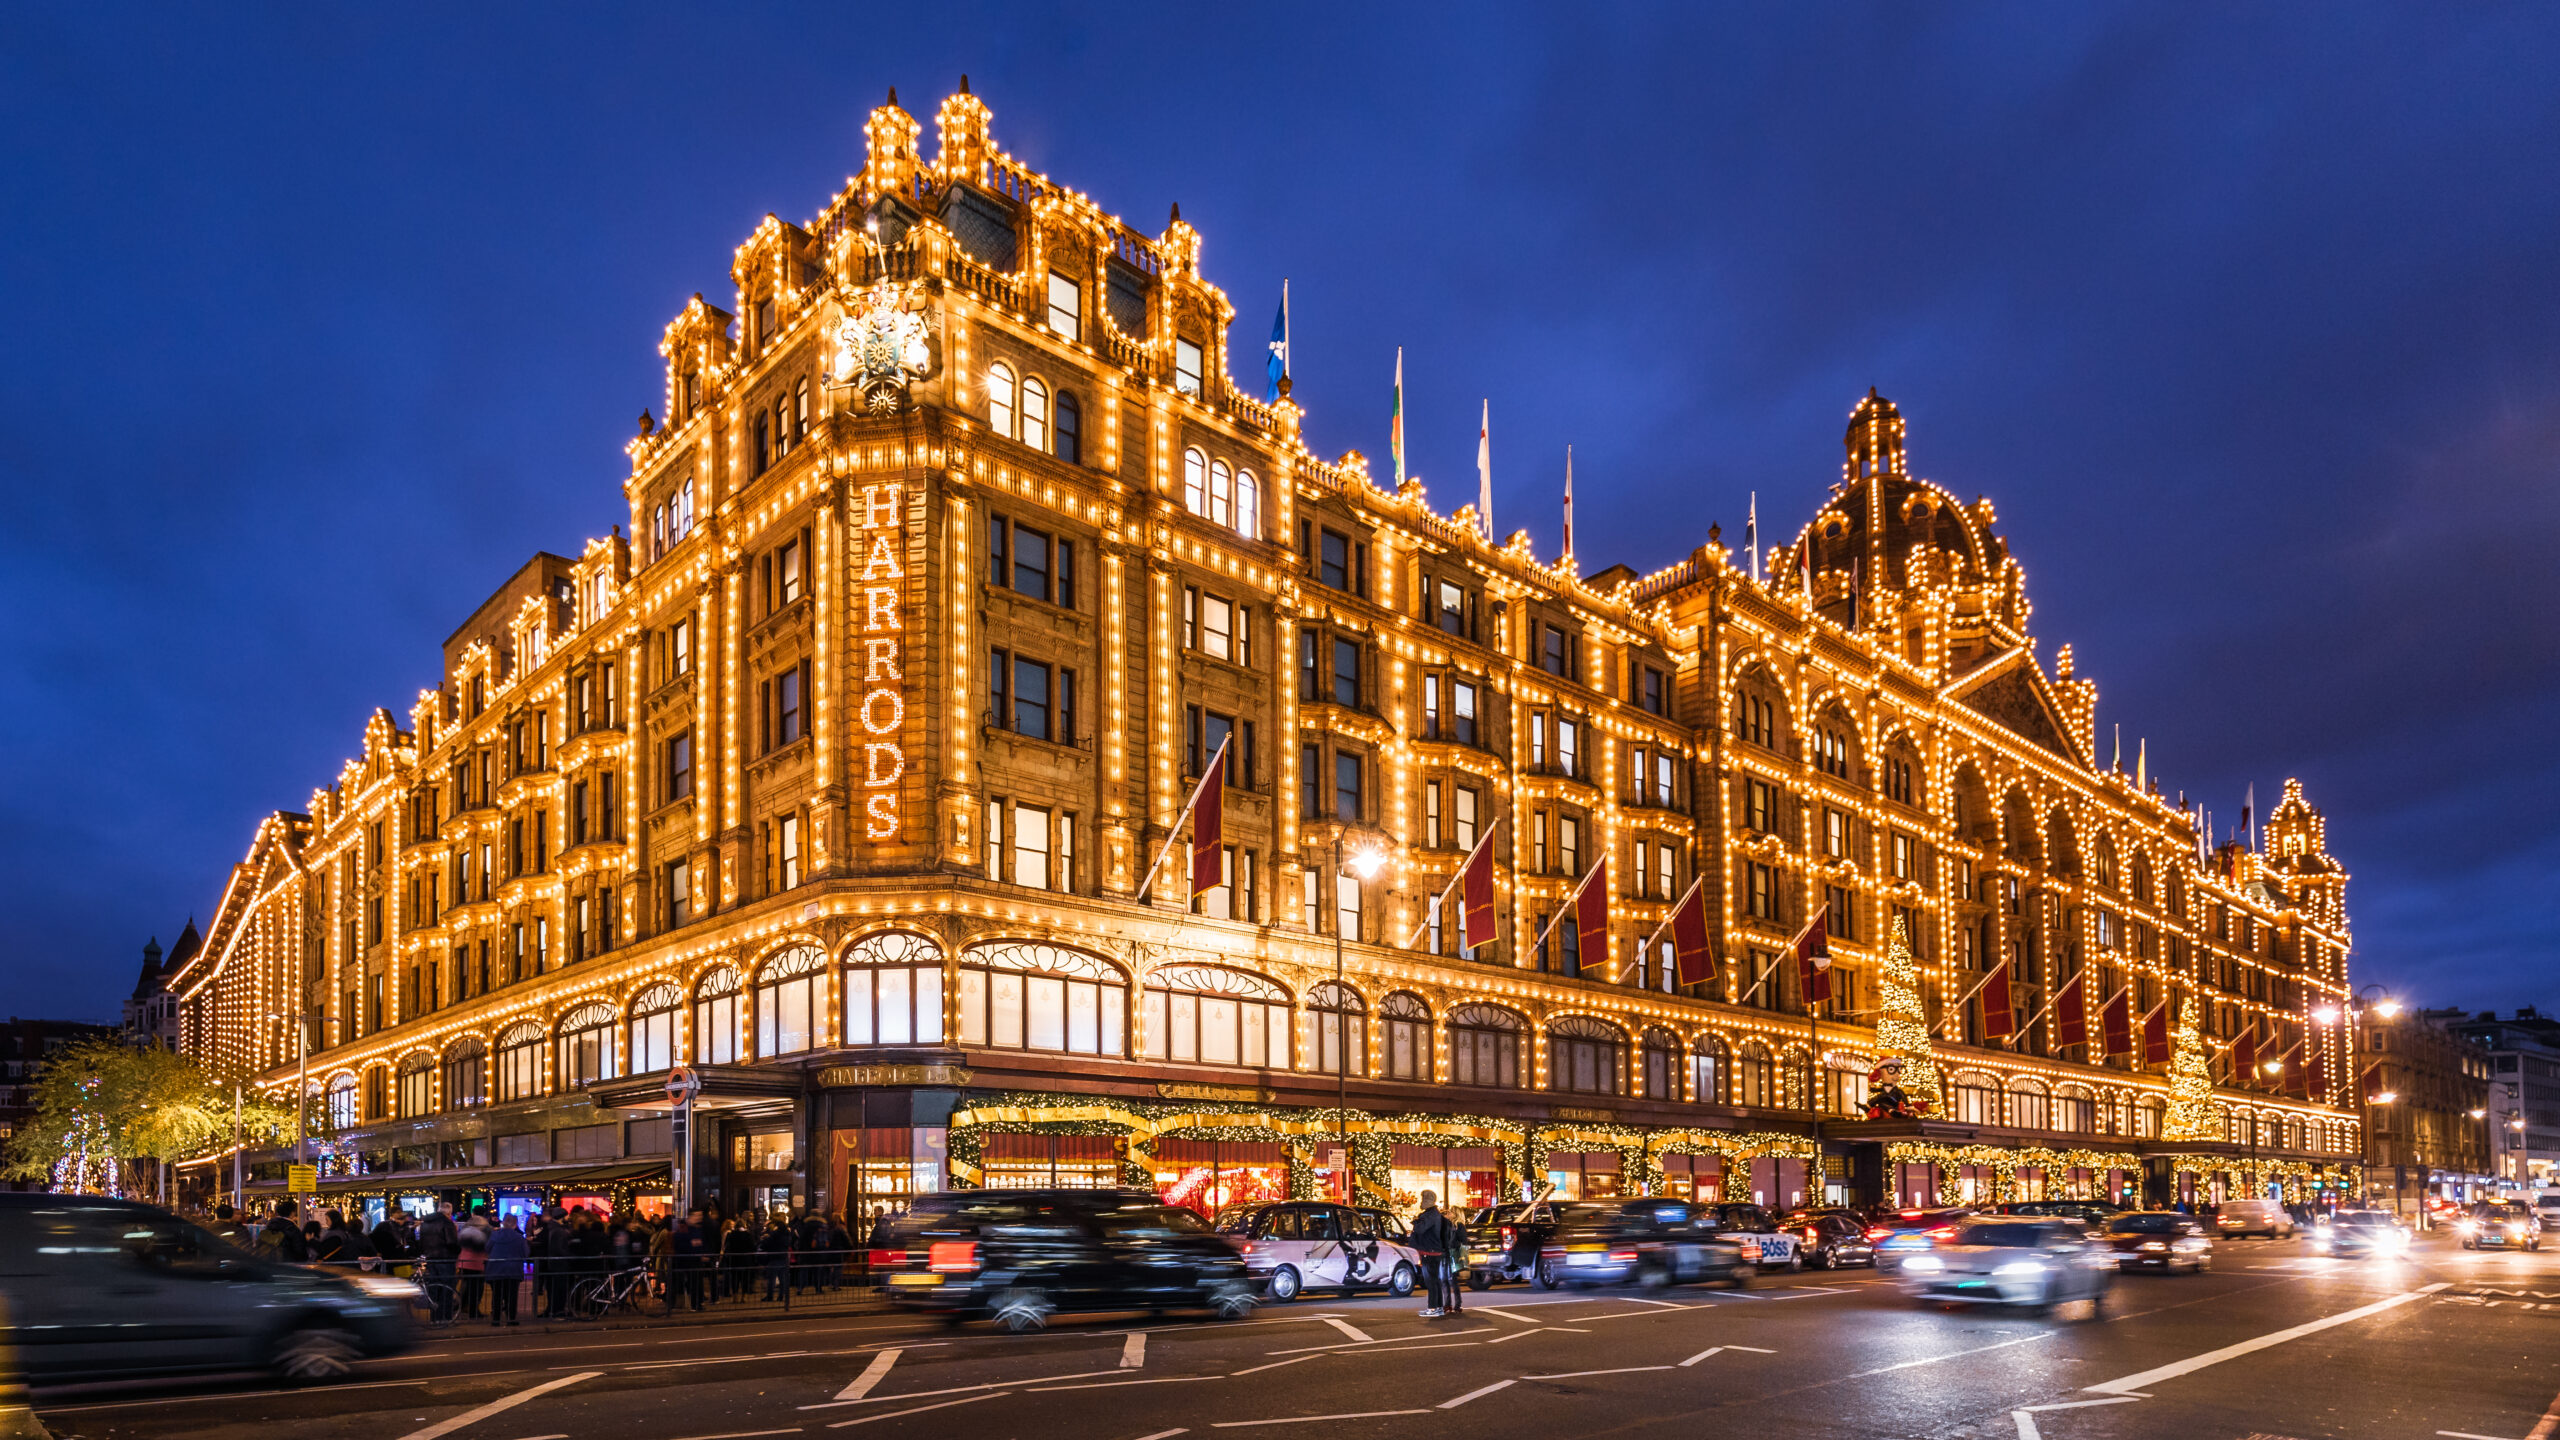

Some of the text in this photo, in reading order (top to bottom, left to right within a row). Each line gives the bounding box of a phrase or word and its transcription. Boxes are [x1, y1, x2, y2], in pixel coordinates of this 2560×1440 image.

[861, 484, 905, 838] HARRODS
[833, 1068, 919, 1084] HARRODS
[1761, 1241, 1789, 1256] BOSS
